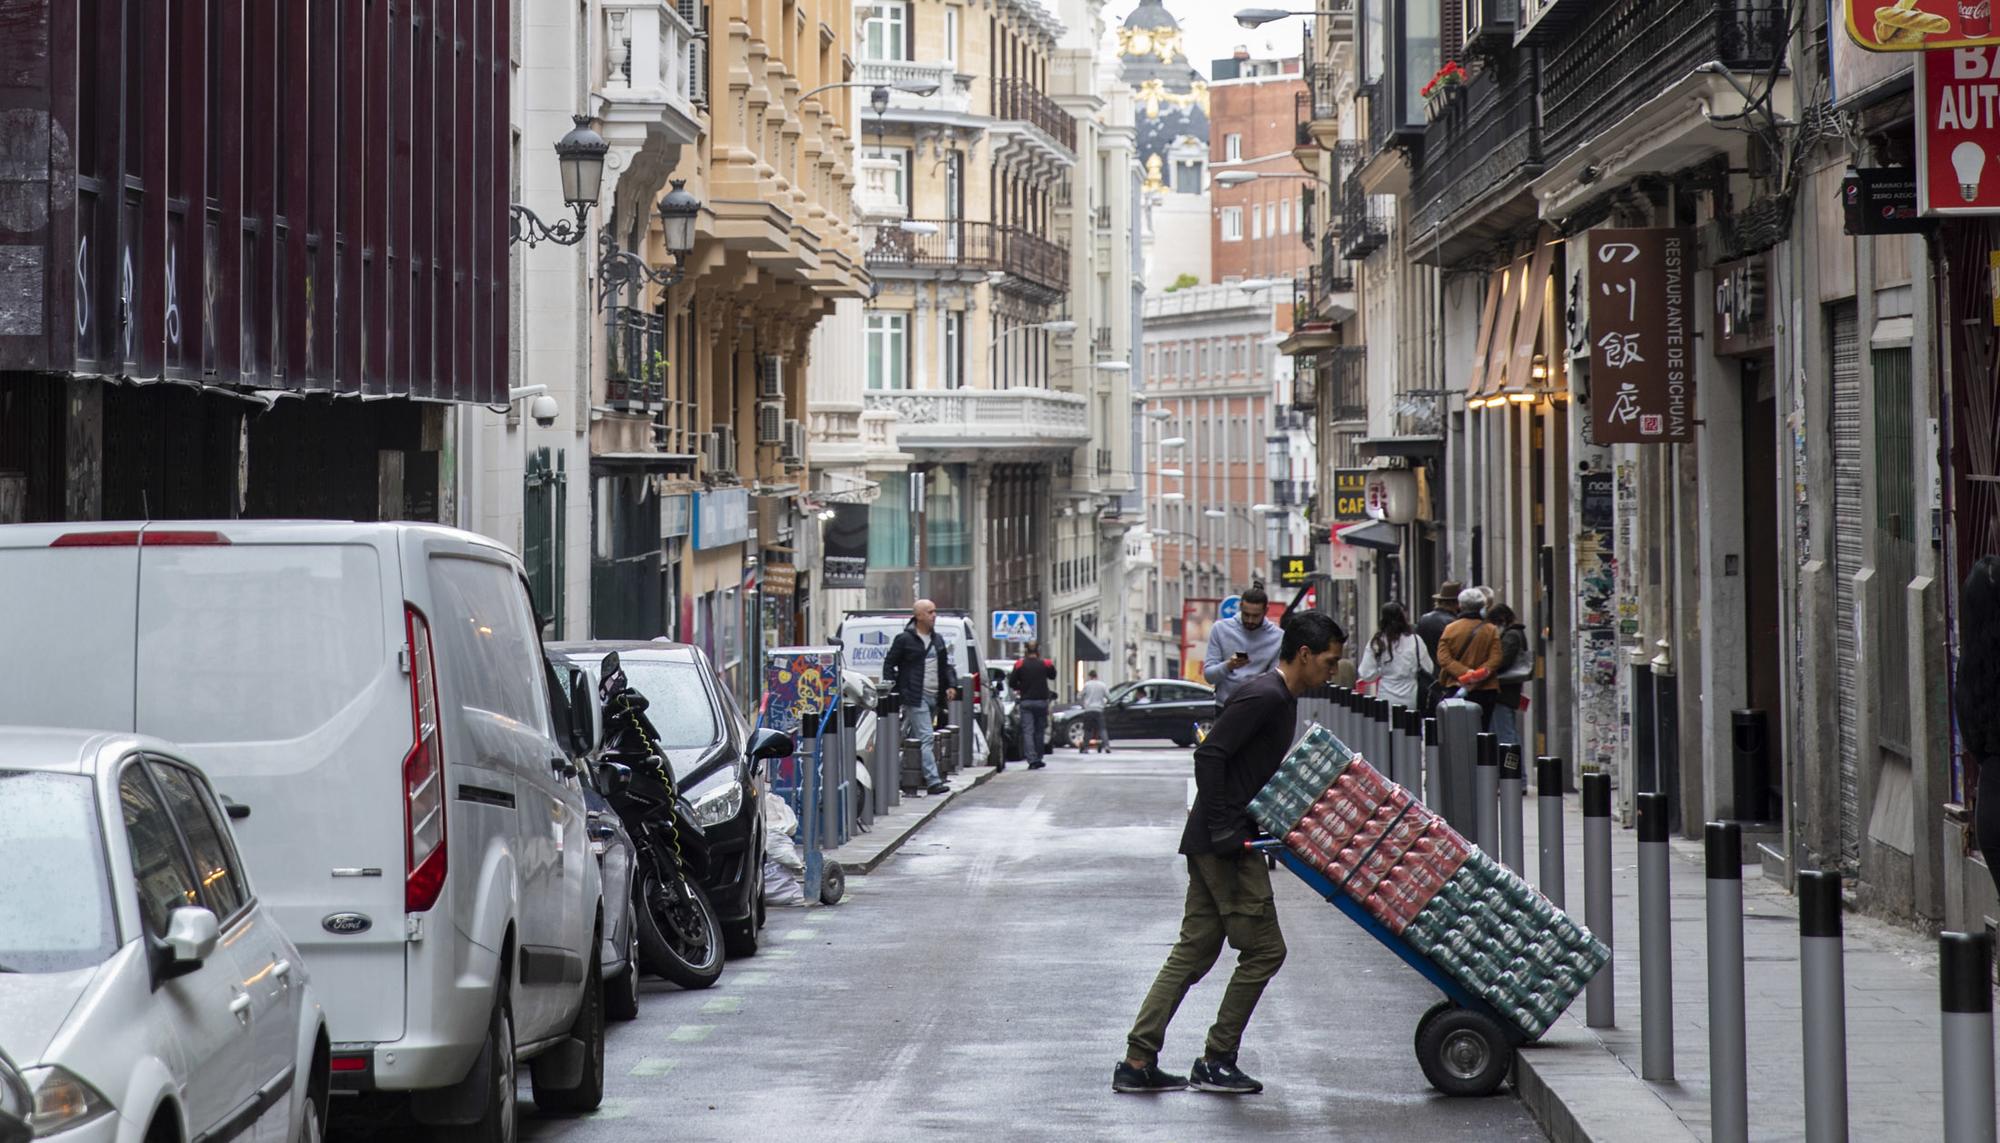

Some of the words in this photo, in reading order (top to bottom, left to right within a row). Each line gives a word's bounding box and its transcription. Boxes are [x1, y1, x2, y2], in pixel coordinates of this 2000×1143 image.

[1954, 47, 2000, 79] B
[1938, 84, 2000, 130] AUT
[1665, 237, 1684, 345] RESTAURANTE
[1668, 347, 1684, 368] DE
[1668, 371, 1685, 436] SICHUAN
[1338, 498, 1365, 514] CAF
[333, 917, 361, 929] Ford
